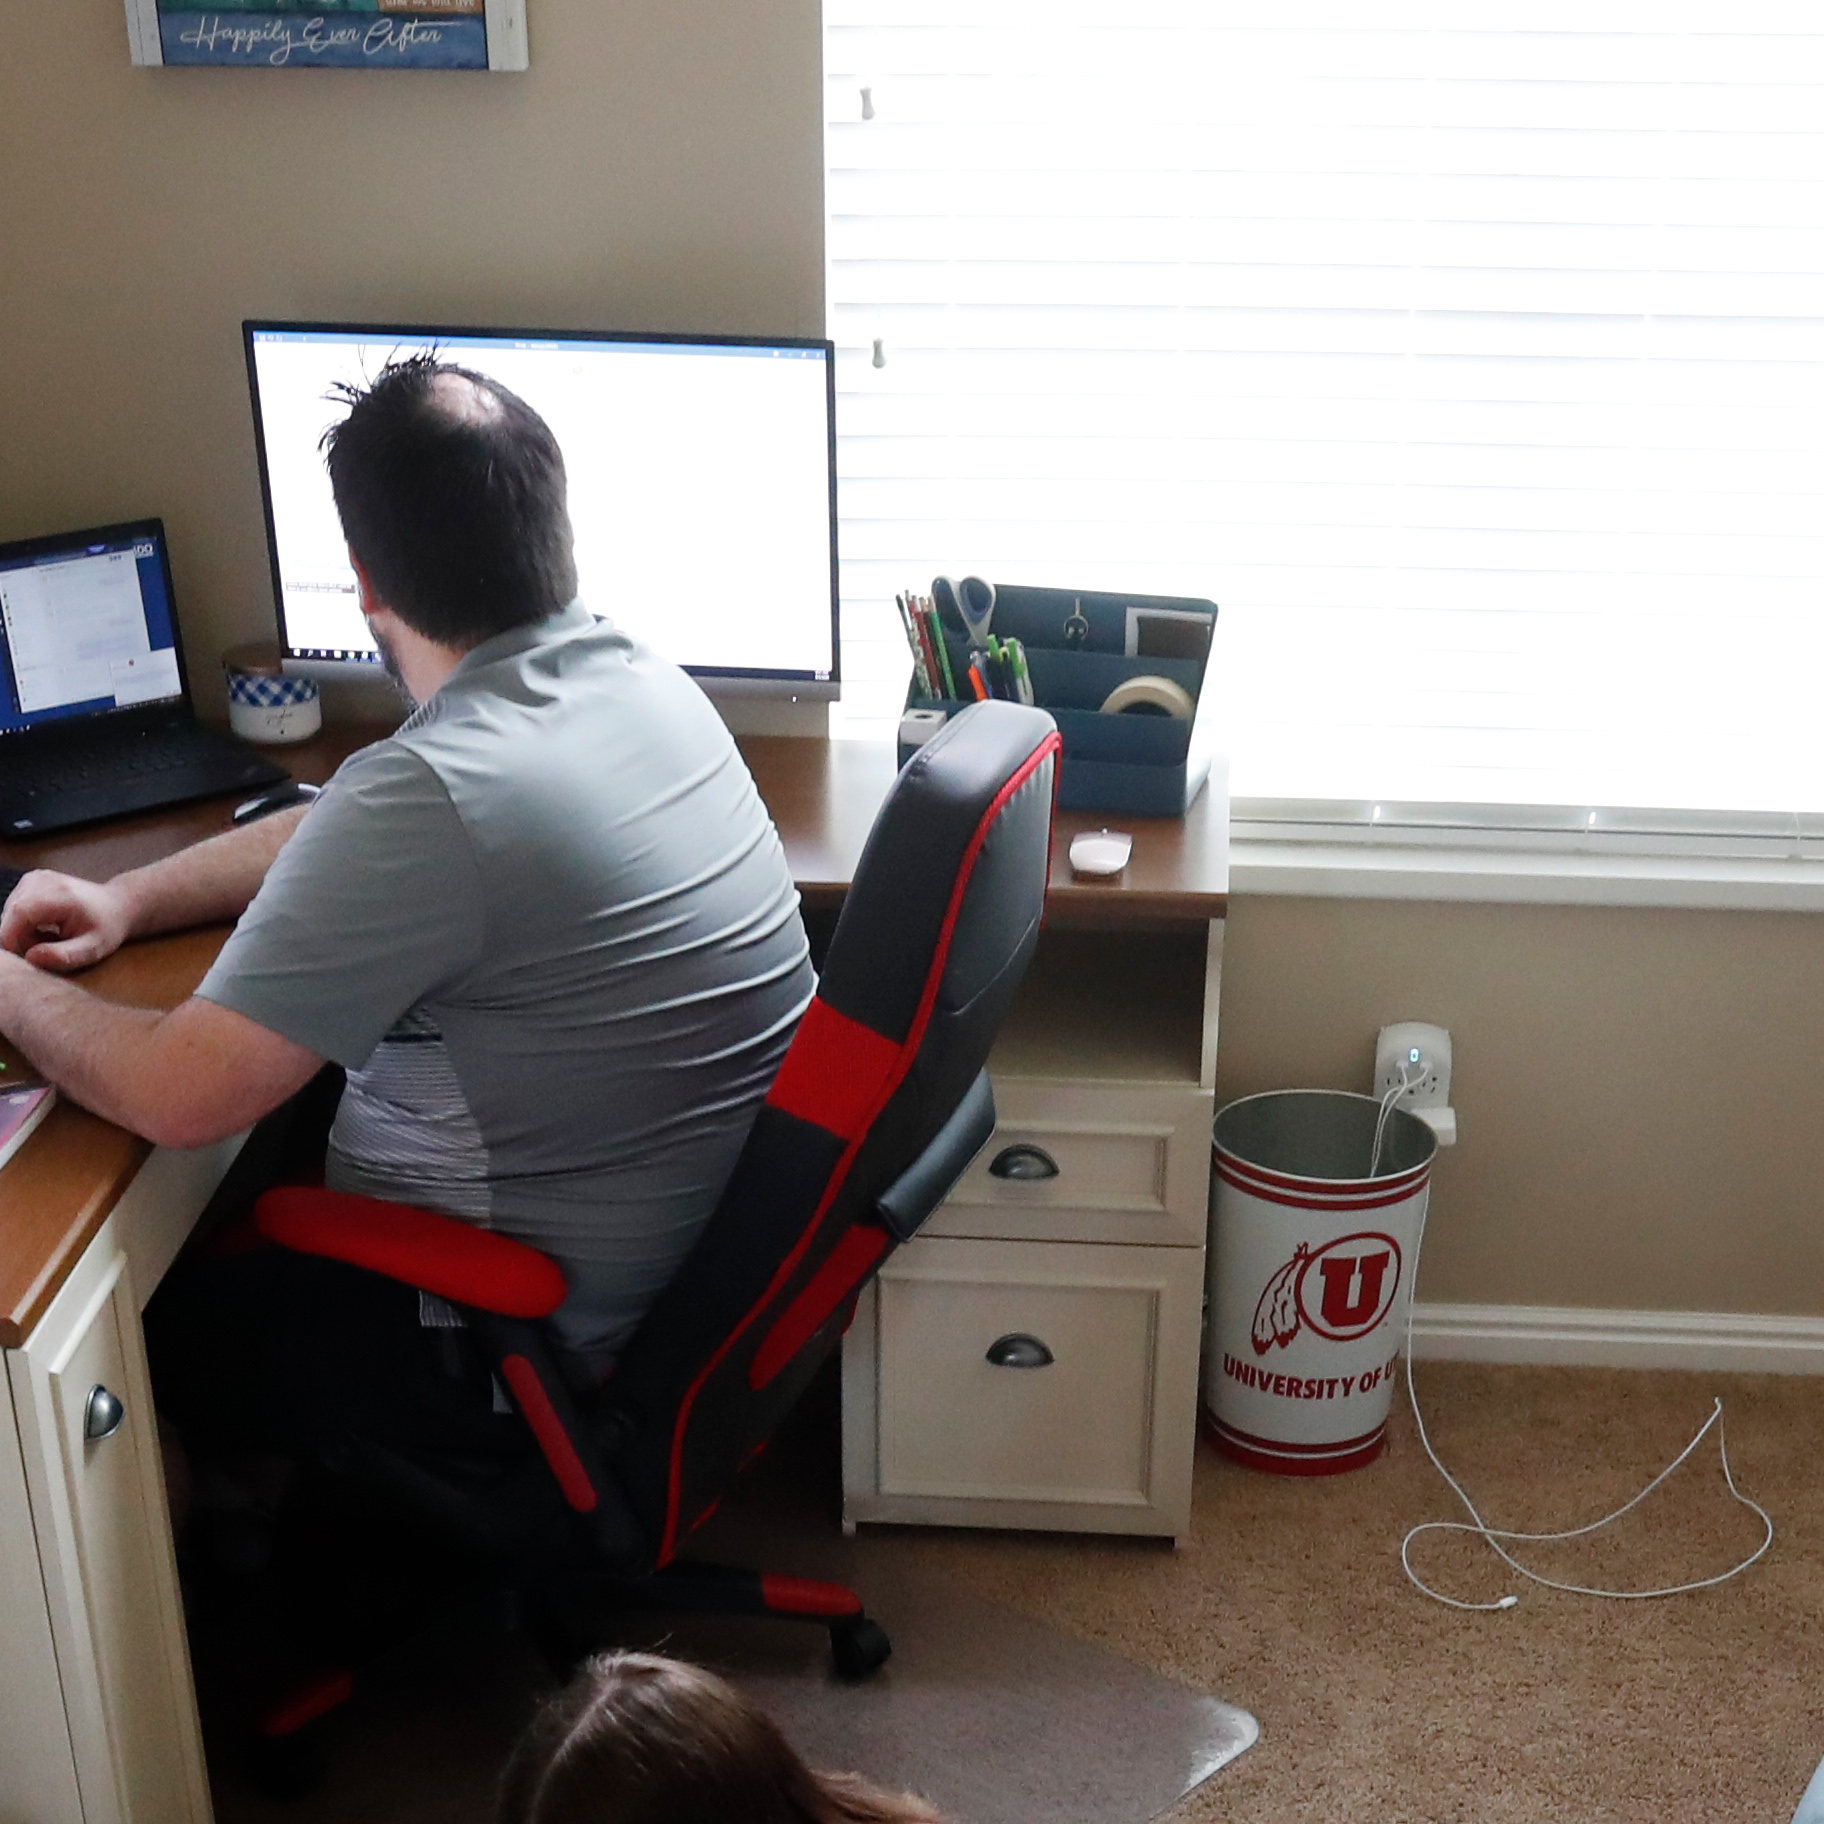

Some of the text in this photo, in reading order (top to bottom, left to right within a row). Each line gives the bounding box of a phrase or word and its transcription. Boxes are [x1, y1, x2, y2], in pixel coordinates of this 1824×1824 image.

[180, 16, 462, 65] Happily Ever After
[1319, 1250, 1390, 1327] U
[1223, 1352, 1356, 1400] UNIVERSITY
[1359, 1366, 1382, 1393] OF
